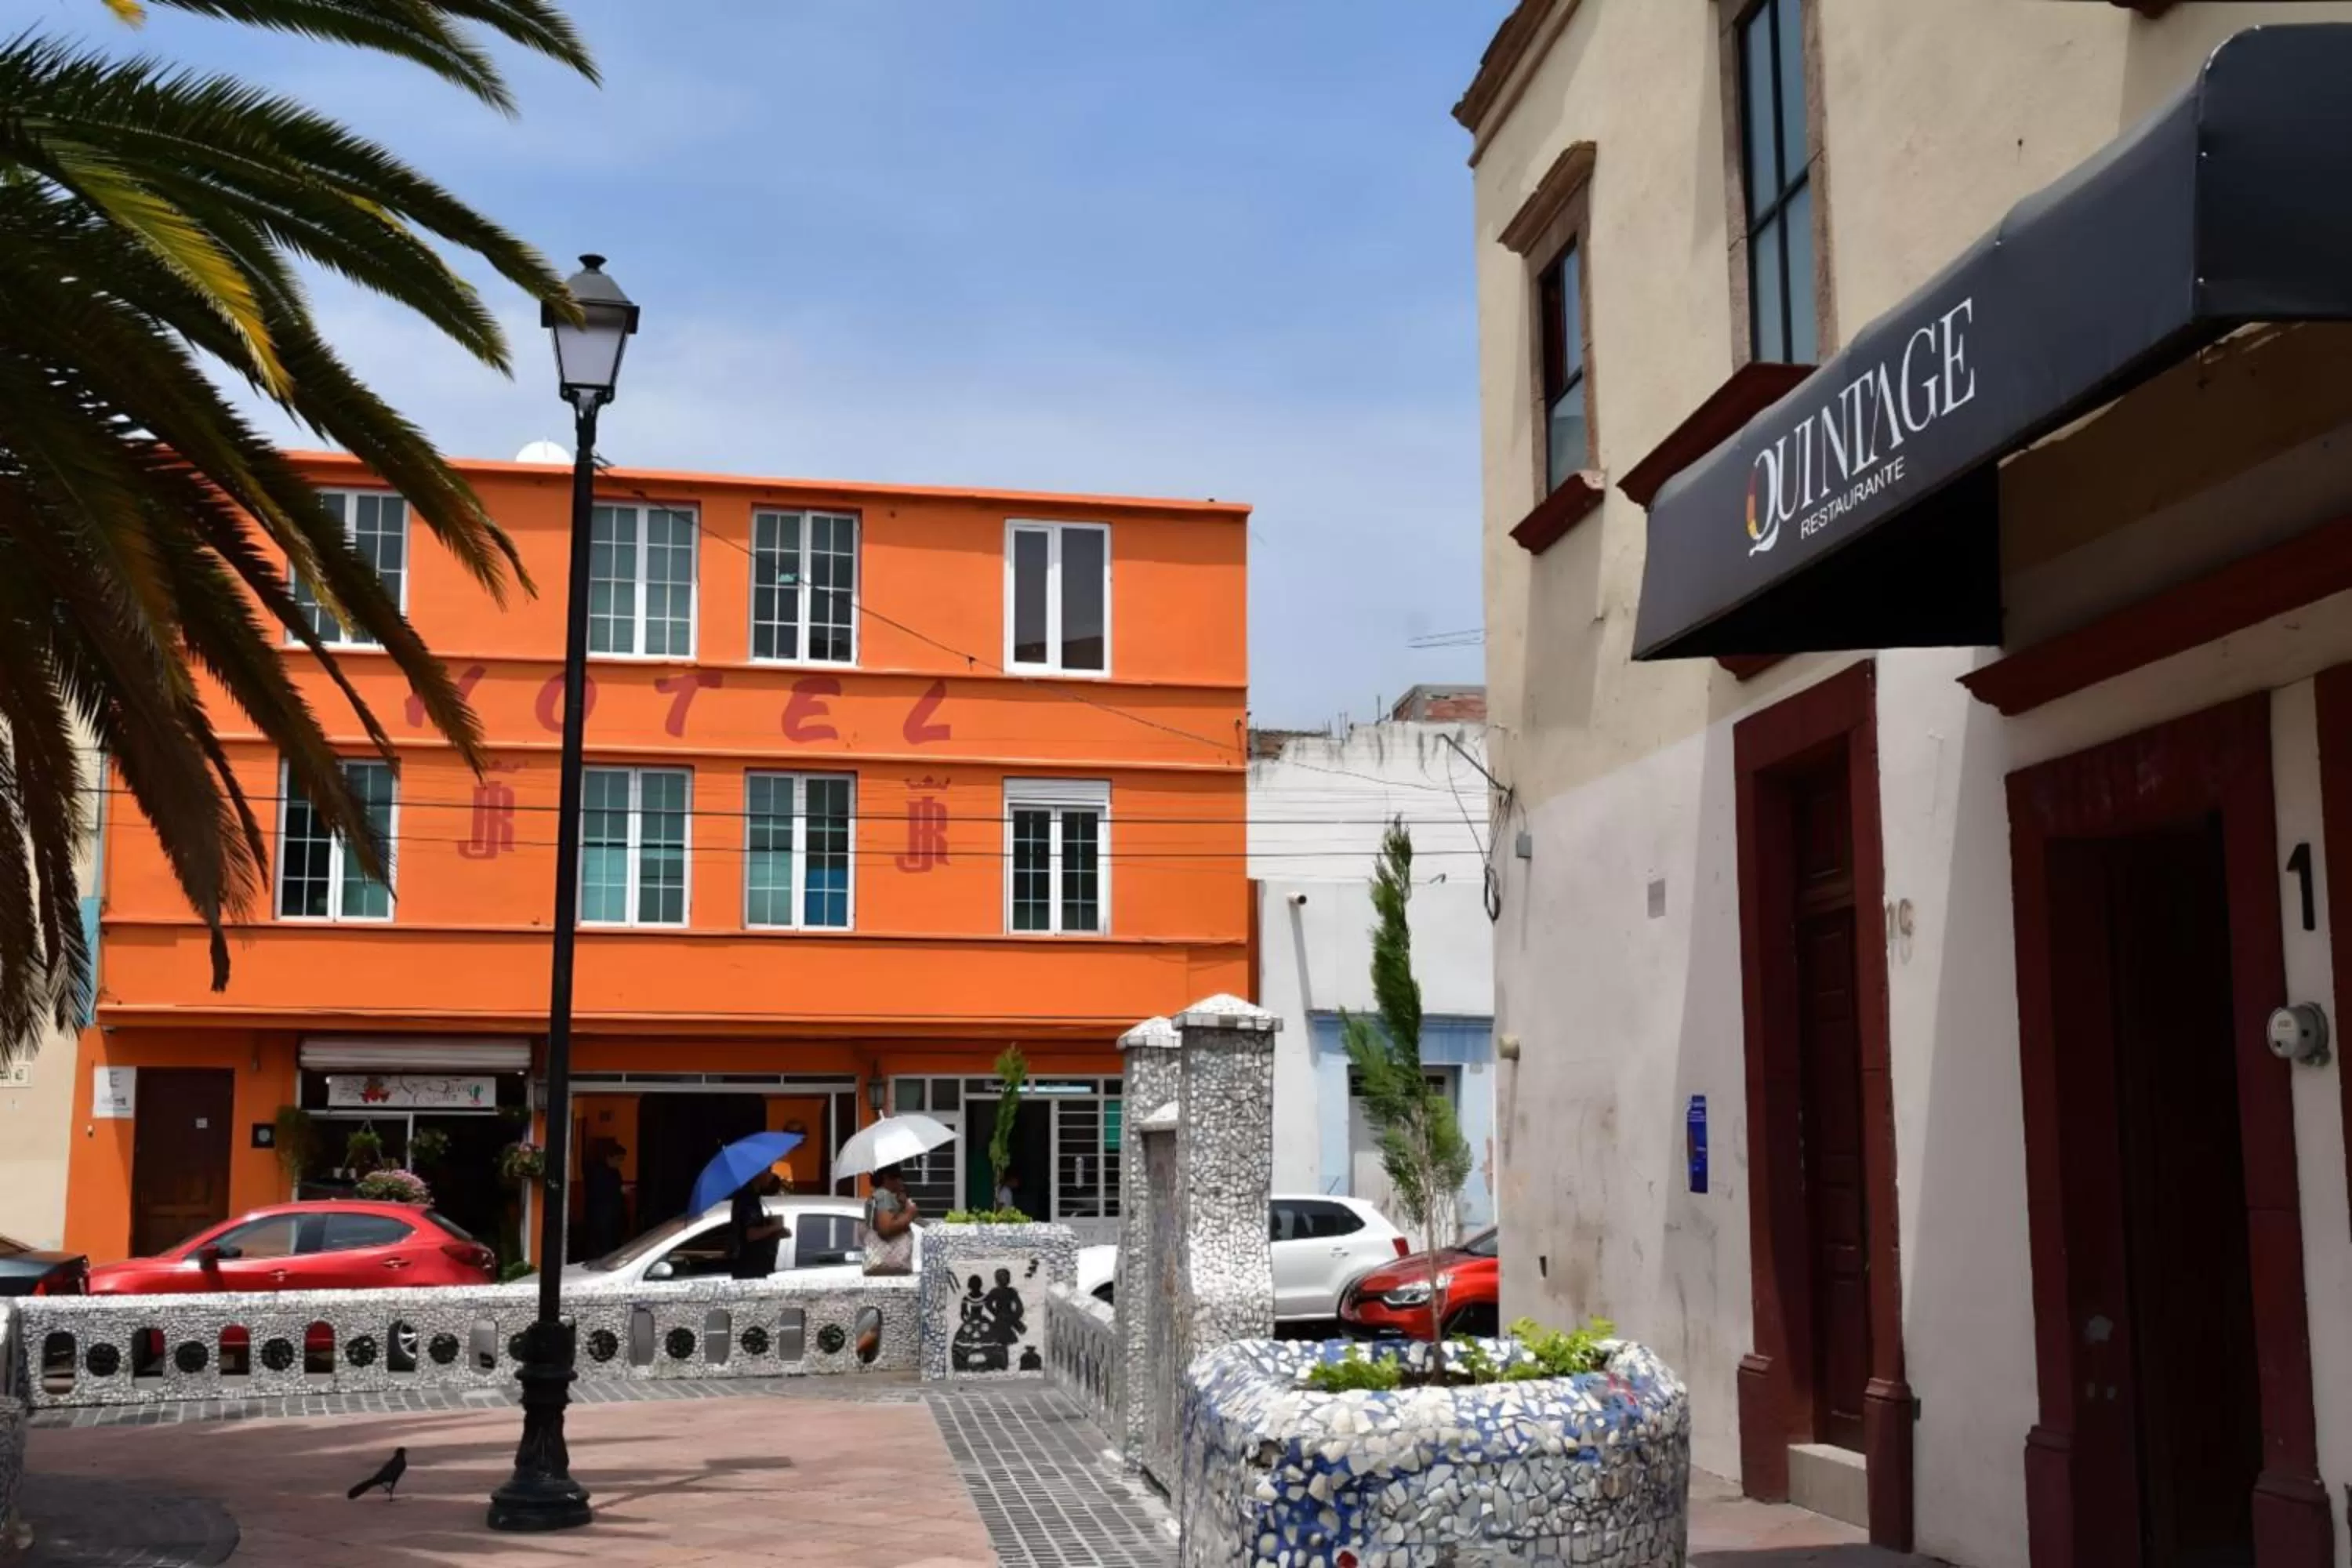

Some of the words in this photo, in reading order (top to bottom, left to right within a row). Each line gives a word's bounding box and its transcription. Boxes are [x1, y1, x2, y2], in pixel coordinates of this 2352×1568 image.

[1746, 296, 1975, 557] QUINTAGE
[1800, 456, 1906, 539] RESTAURANTE
[2286, 842, 2316, 931] 1
